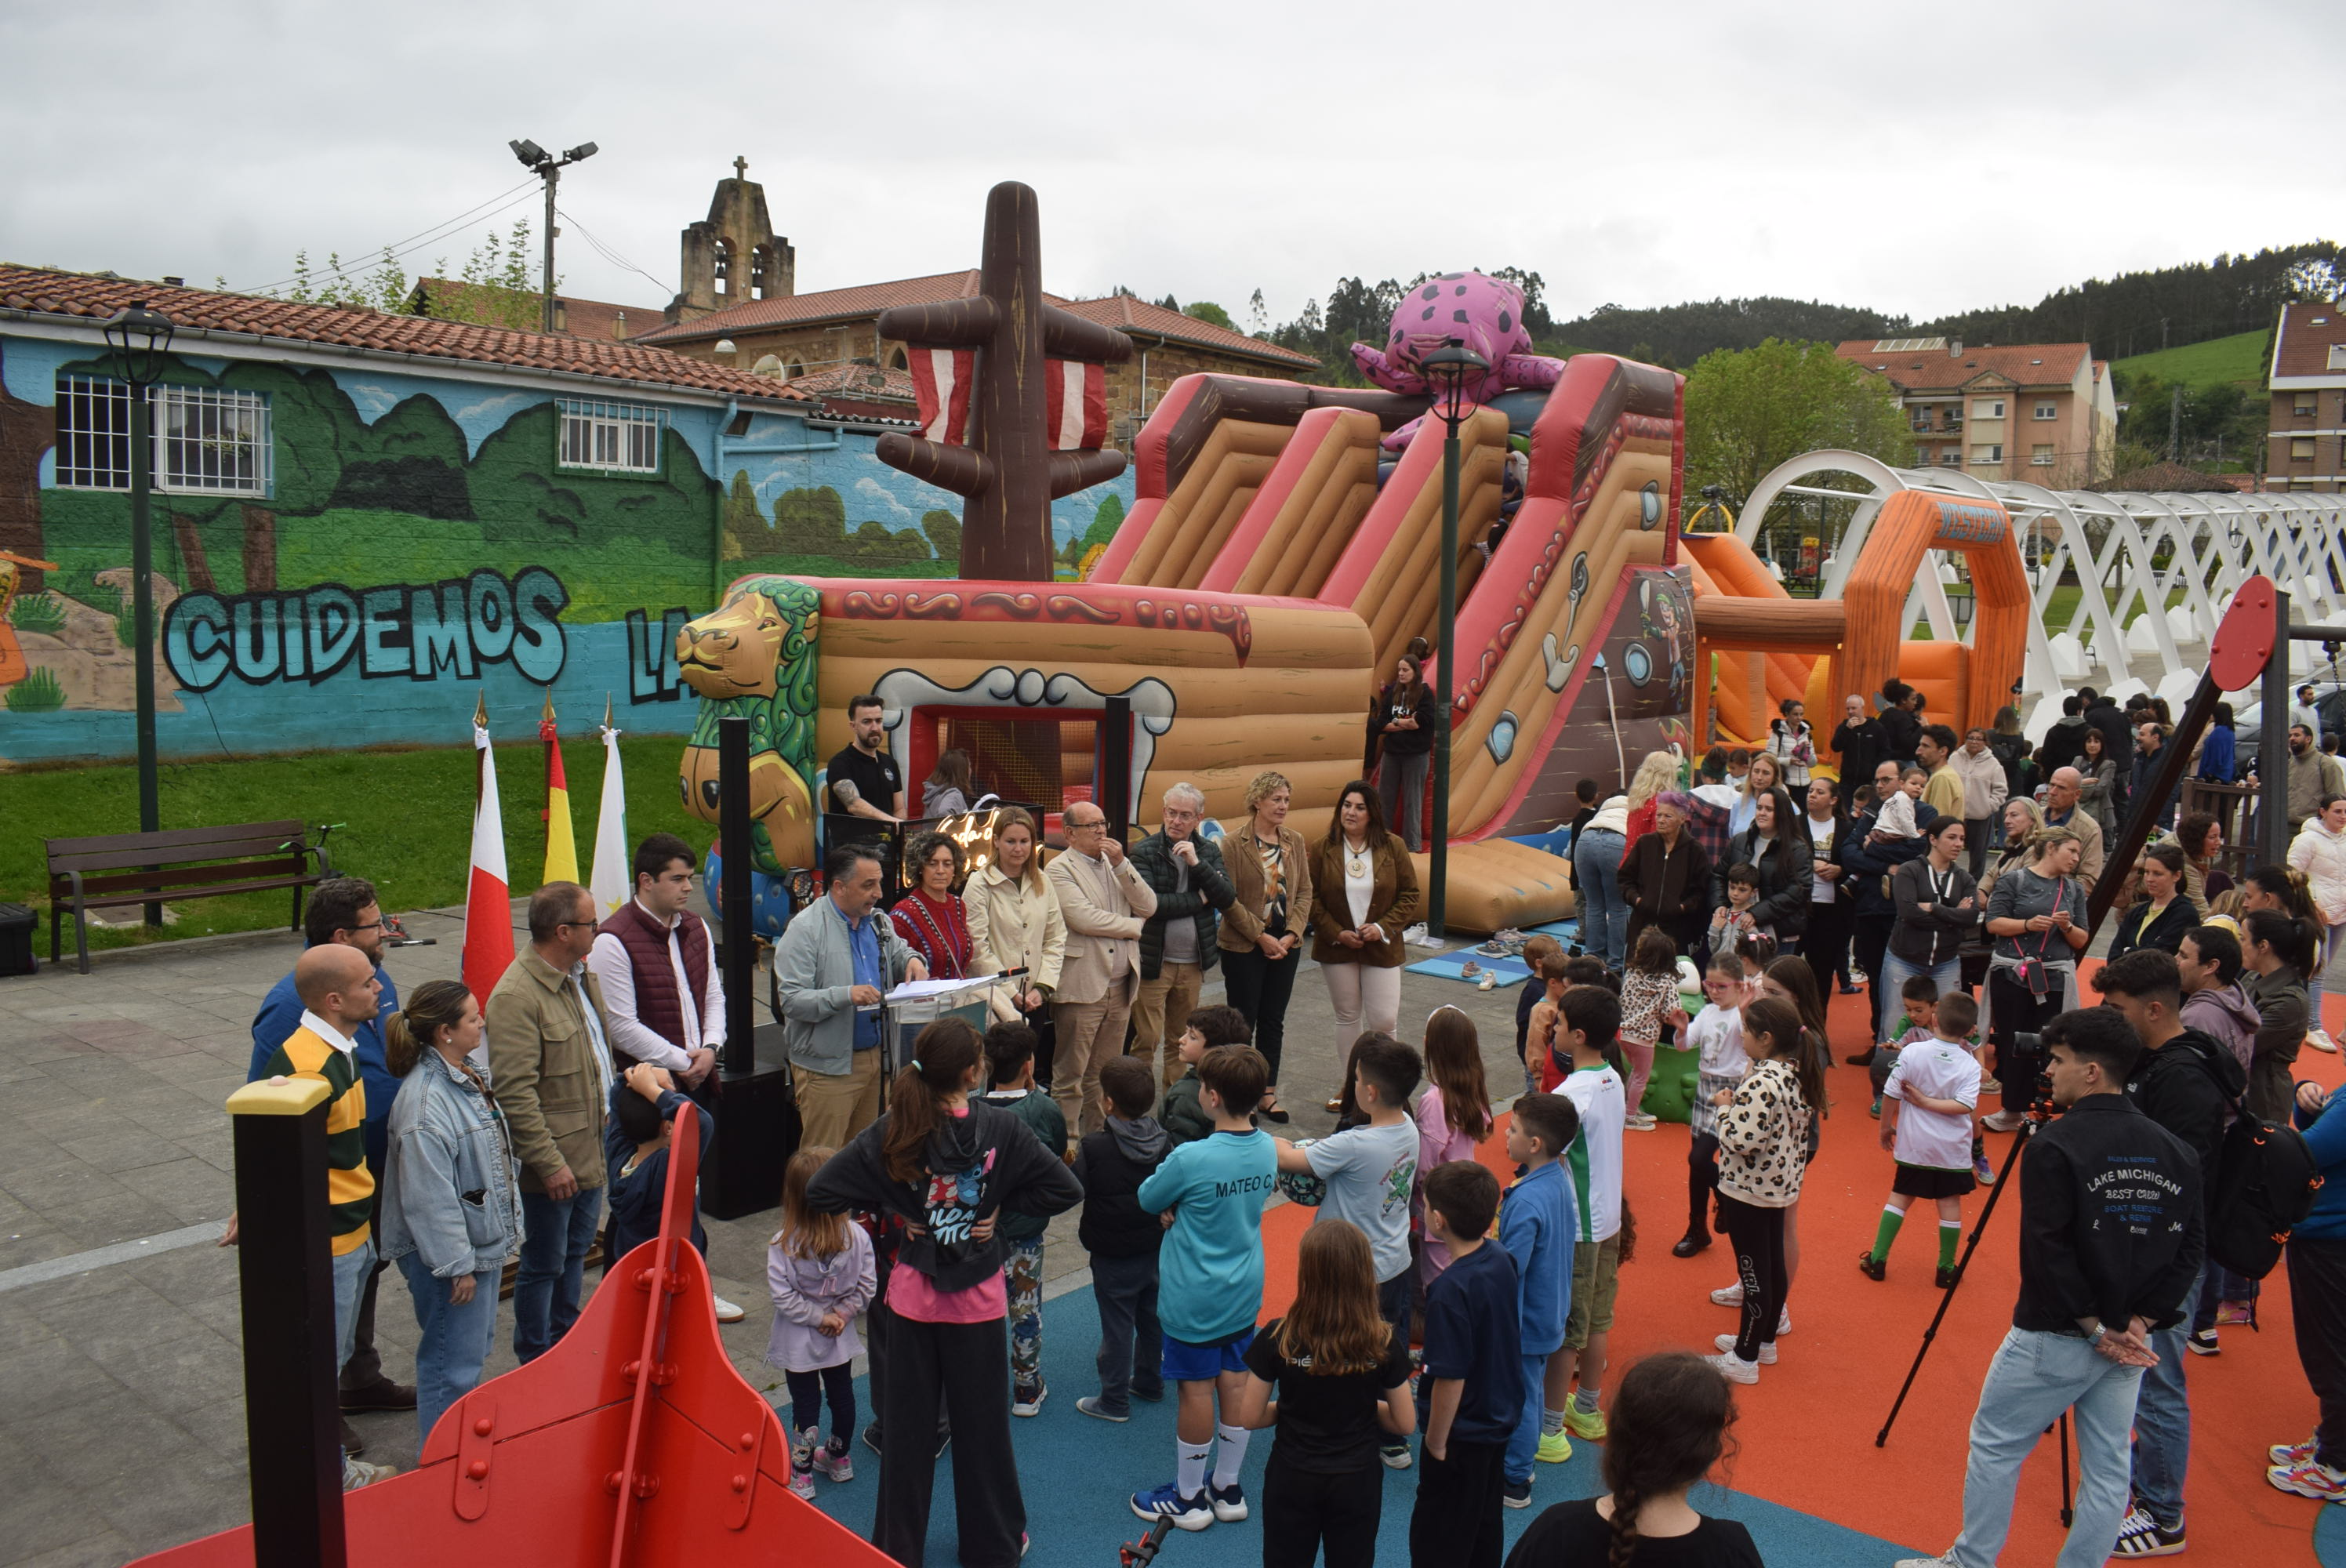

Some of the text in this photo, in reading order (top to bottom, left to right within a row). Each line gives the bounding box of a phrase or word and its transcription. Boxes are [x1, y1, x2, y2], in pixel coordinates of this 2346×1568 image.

[1937, 502, 2006, 543] WESTERN
[162, 565, 571, 693] CUIDEMOS
[1215, 1176, 1261, 1198] MATEO
[2086, 1168, 2181, 1195] LAKE MICHIGAN
[2105, 1189, 2160, 1200] BEST CREW
[2168, 1221, 2182, 1232] M
